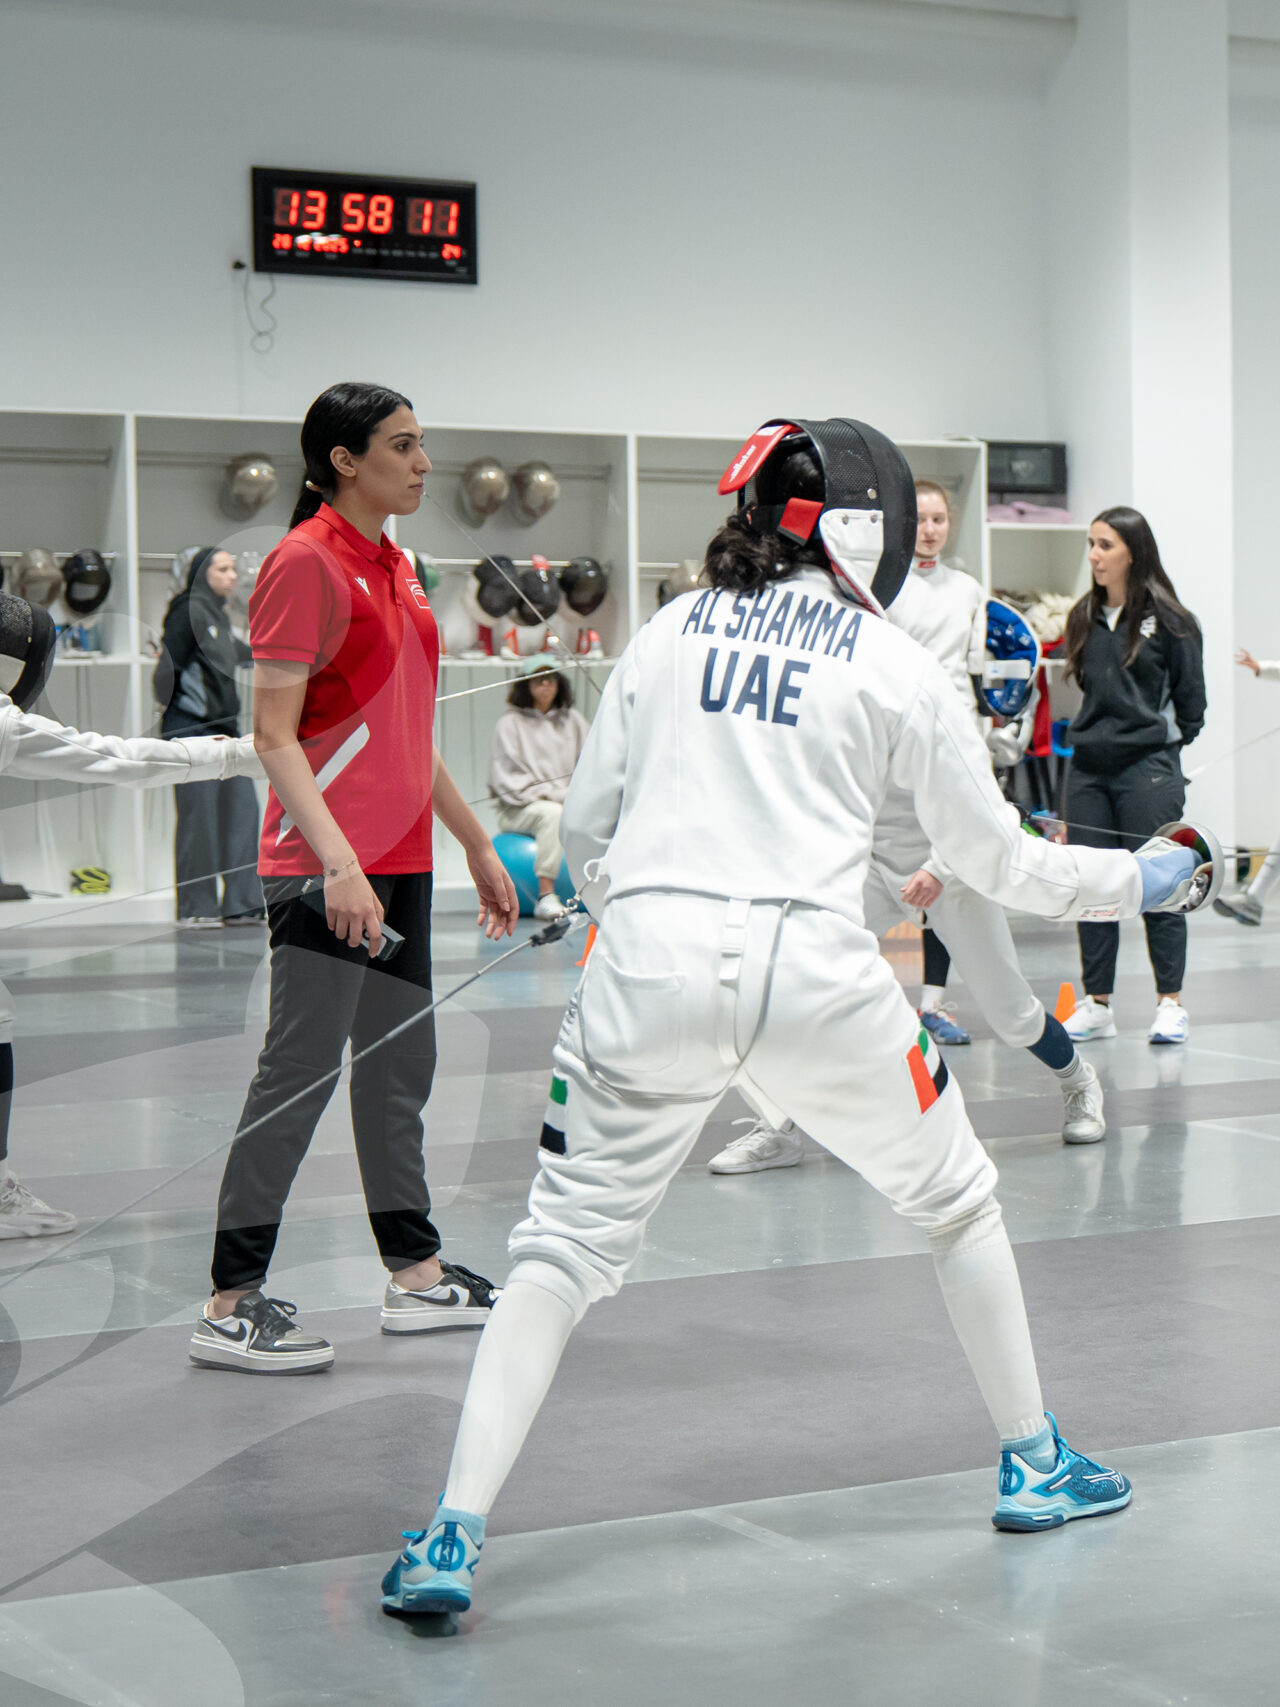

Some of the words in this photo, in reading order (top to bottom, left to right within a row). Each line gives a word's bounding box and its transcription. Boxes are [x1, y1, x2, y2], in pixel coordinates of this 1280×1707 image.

[286, 189, 328, 230] 13
[342, 193, 394, 235] 58
[419, 200, 460, 236] 11
[681, 588, 720, 635] AL
[724, 588, 863, 663] SHAMMA
[699, 647, 811, 727] UAE
